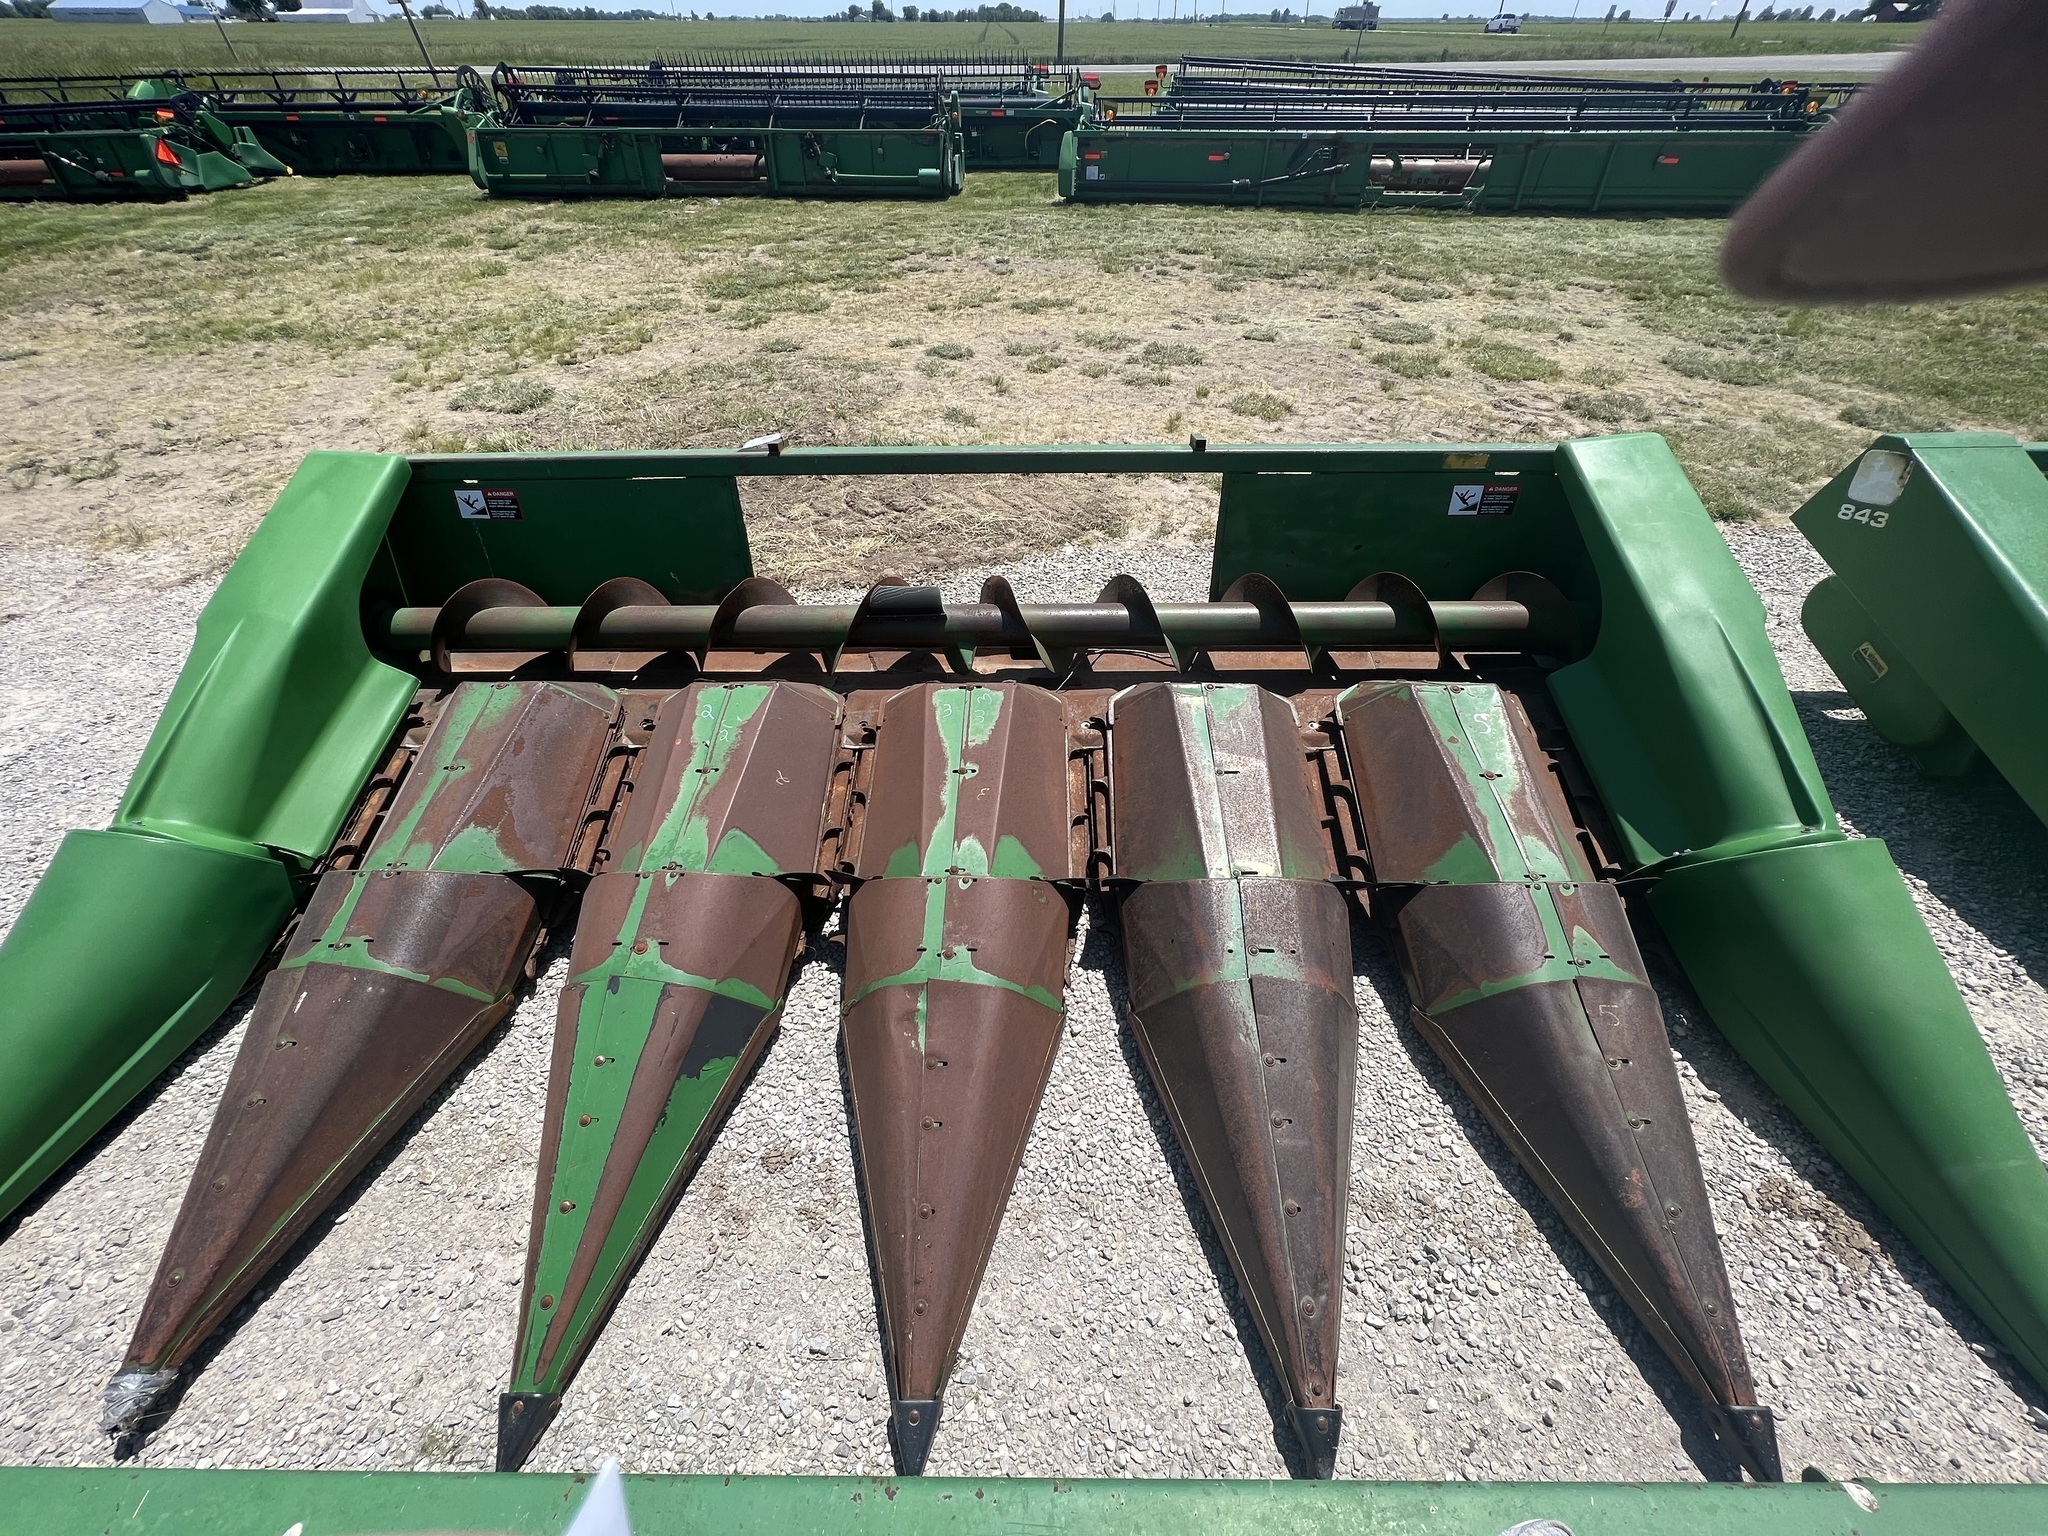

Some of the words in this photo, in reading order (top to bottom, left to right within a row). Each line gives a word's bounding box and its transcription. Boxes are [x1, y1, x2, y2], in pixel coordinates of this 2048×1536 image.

[1837, 503, 1889, 528] 843
[701, 703, 714, 720] 2
[943, 703, 953, 718] 3
[1599, 1004, 1620, 1027] 5
